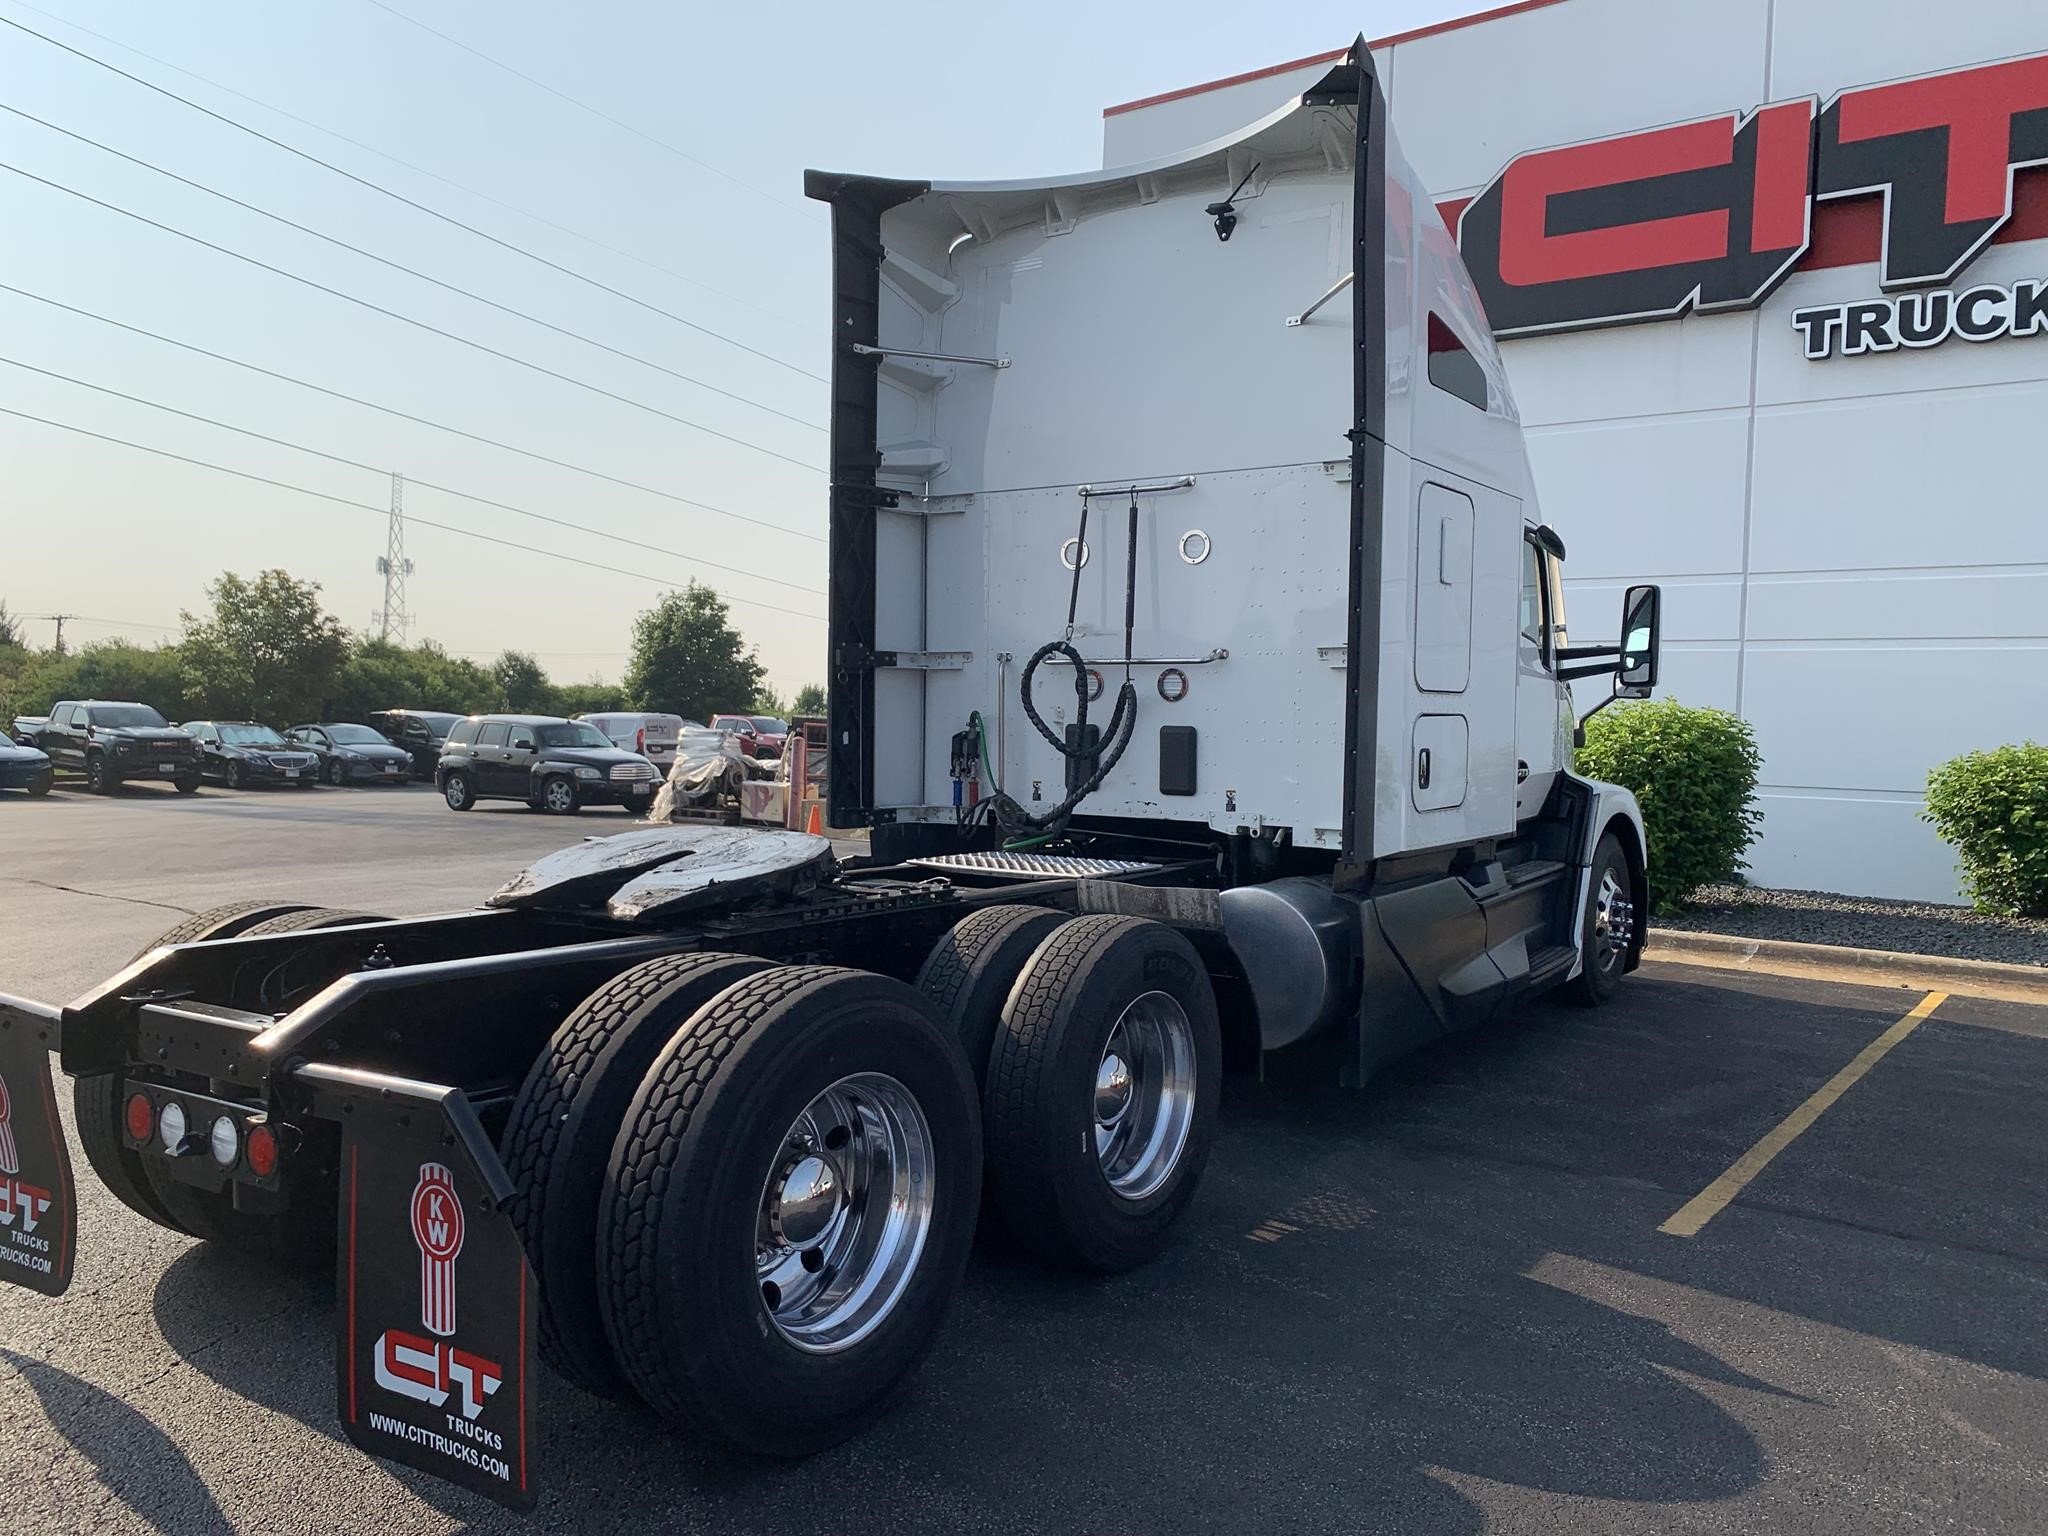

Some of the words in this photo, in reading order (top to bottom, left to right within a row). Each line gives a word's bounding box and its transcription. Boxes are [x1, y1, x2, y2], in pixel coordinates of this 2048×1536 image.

[1462, 54, 2048, 322] CIT
[0, 1175, 52, 1232] IT
[11, 1230, 50, 1253] TRUCKS
[374, 1328, 502, 1420] CIT
[369, 1412, 510, 1481] WWW.CITTRUCKS.COM
[446, 1414, 503, 1450] TRUCKS
